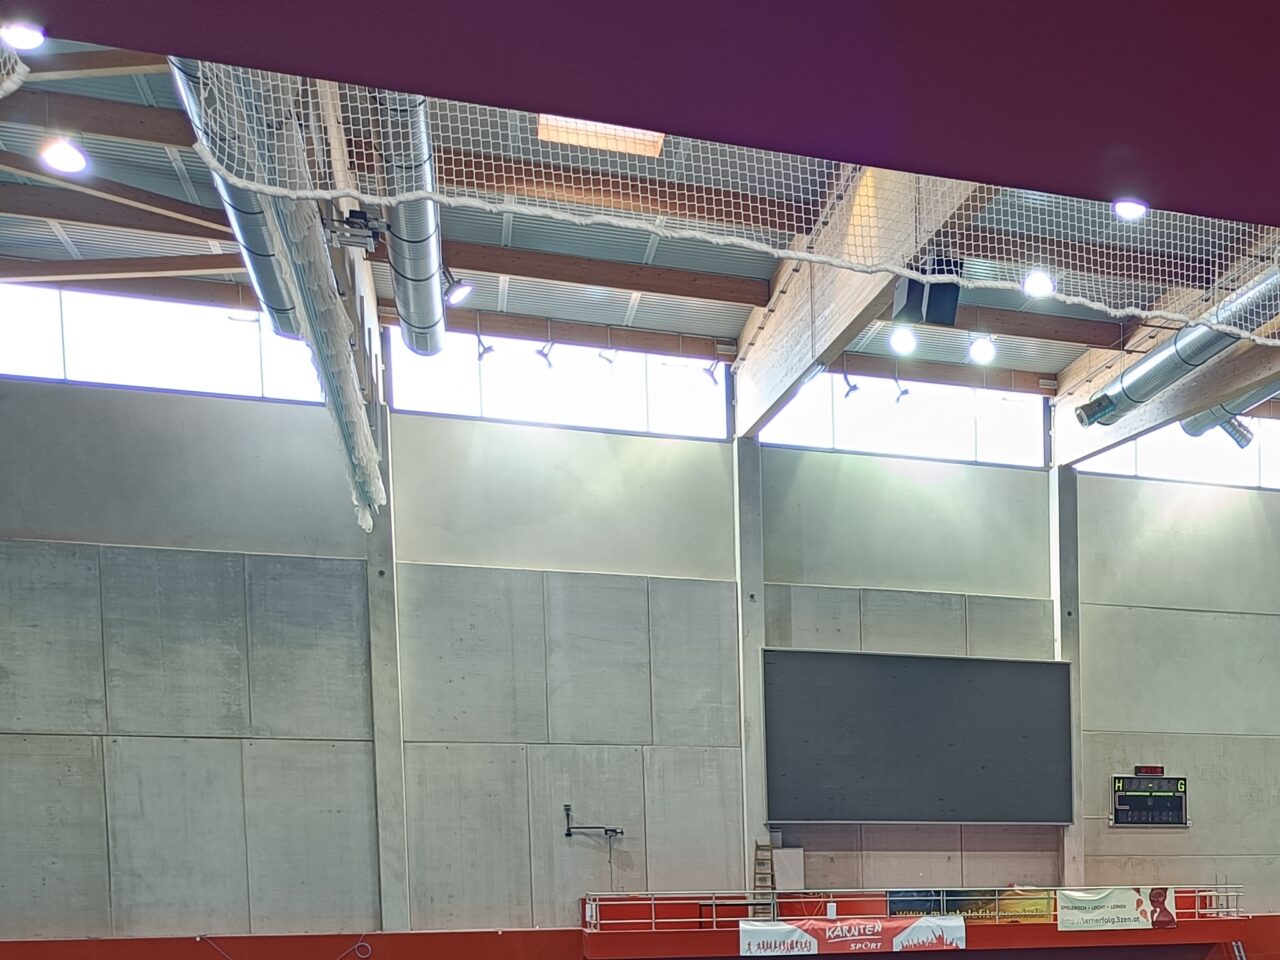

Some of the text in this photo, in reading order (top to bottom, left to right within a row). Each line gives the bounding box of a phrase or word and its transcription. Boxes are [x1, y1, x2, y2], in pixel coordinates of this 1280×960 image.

[1115, 779, 1185, 792] H G
[825, 919, 883, 939] KÄRNTEN
[850, 942, 882, 951] SPORT
